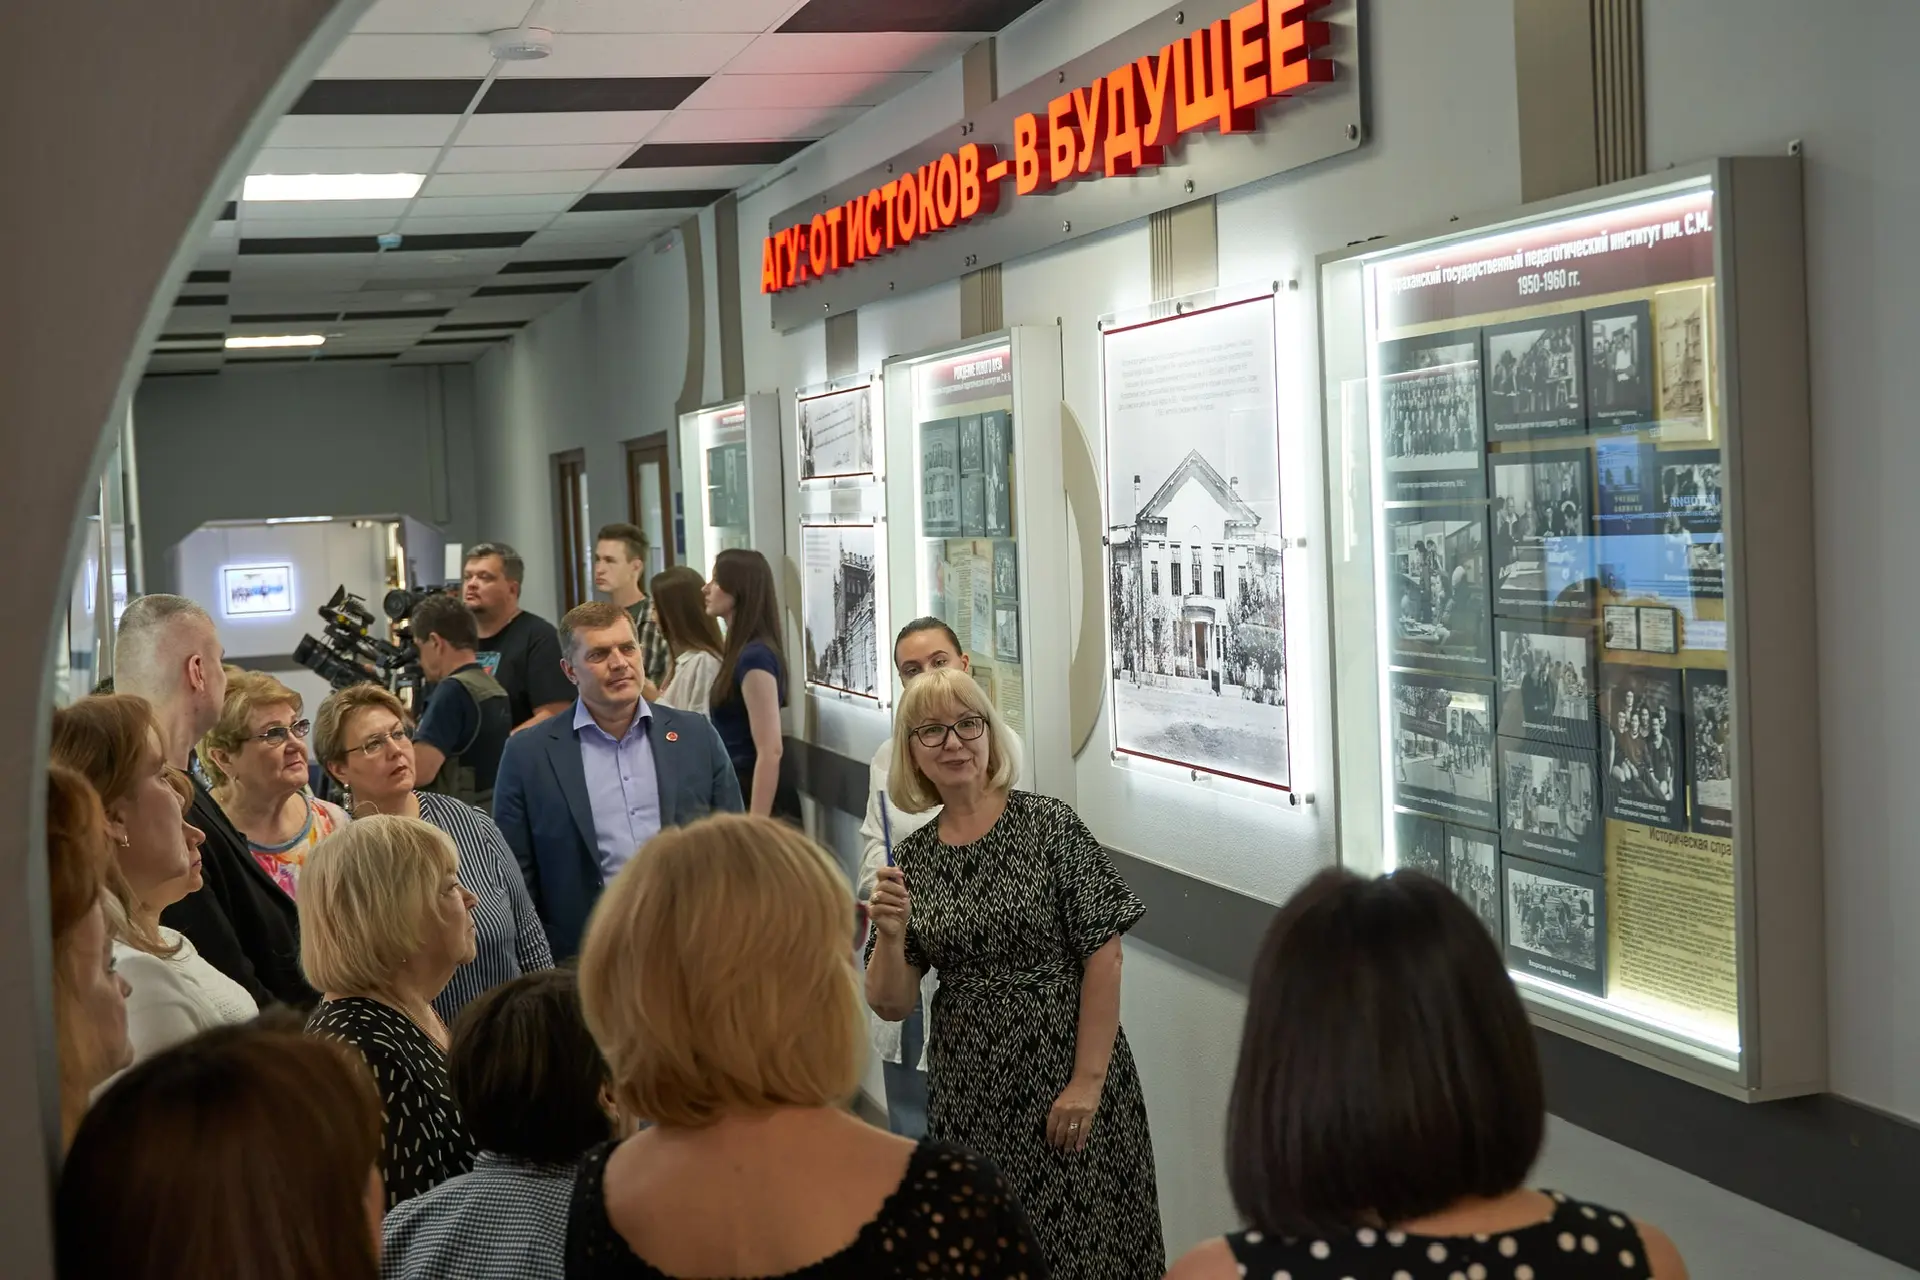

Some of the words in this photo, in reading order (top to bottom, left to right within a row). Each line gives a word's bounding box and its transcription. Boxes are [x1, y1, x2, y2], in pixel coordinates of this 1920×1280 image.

[760, 223, 807, 294] АГУ:
[809, 206, 842, 276] ОТ
[846, 142, 981, 264] ИСТОКОВ
[1013, 112, 1040, 196] В
[1048, 0, 1309, 183] БУДУЩЕЕ
[1442, 248, 1523, 285] государственный
[1524, 231, 1609, 268] педагогический
[1609, 223, 1662, 248] институт
[1517, 268, 1567, 296] 1950-1960
[1568, 270, 1581, 288] гг.
[1649, 825, 1709, 851] Историческая
